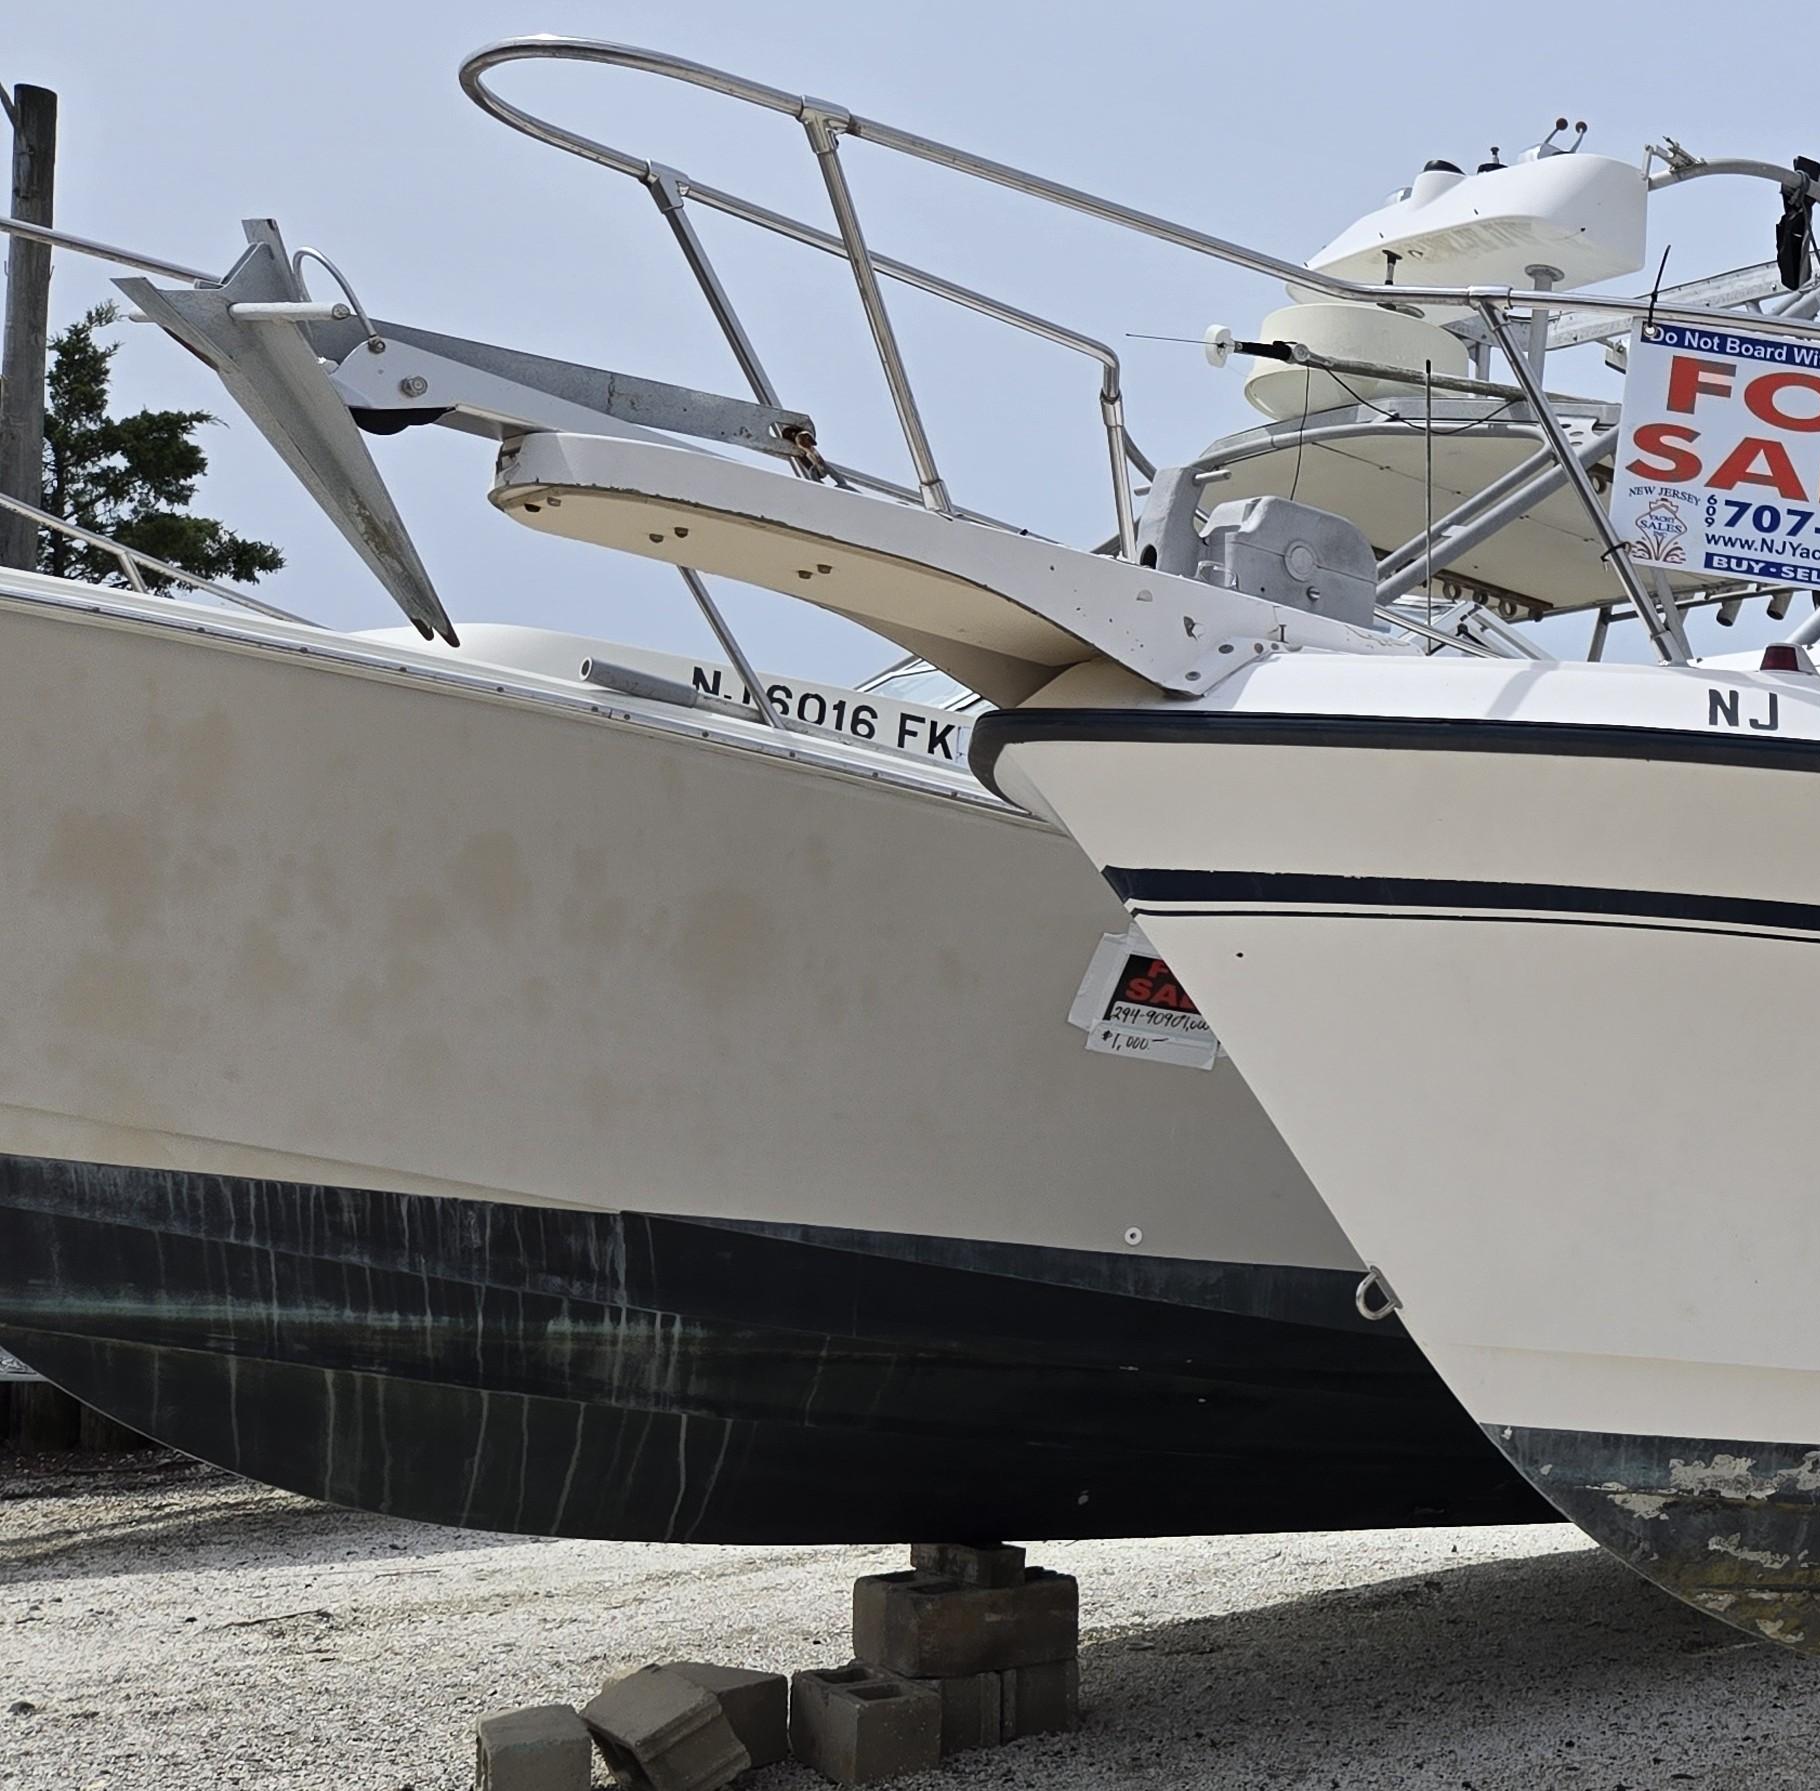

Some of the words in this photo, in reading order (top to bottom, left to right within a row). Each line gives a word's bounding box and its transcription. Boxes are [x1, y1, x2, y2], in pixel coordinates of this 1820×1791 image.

[1684, 331, 1720, 351] Not
[1726, 337, 1786, 361] Board
[1629, 486, 1656, 497] NEW
[1658, 487, 1701, 506] JERSEY
[1705, 494, 1717, 527] 609
[1640, 520, 1682, 533] SALES
[1712, 556, 1766, 574] BUY
[1709, 689, 1778, 730] NJ
[897, 712, 955, 760] FK
